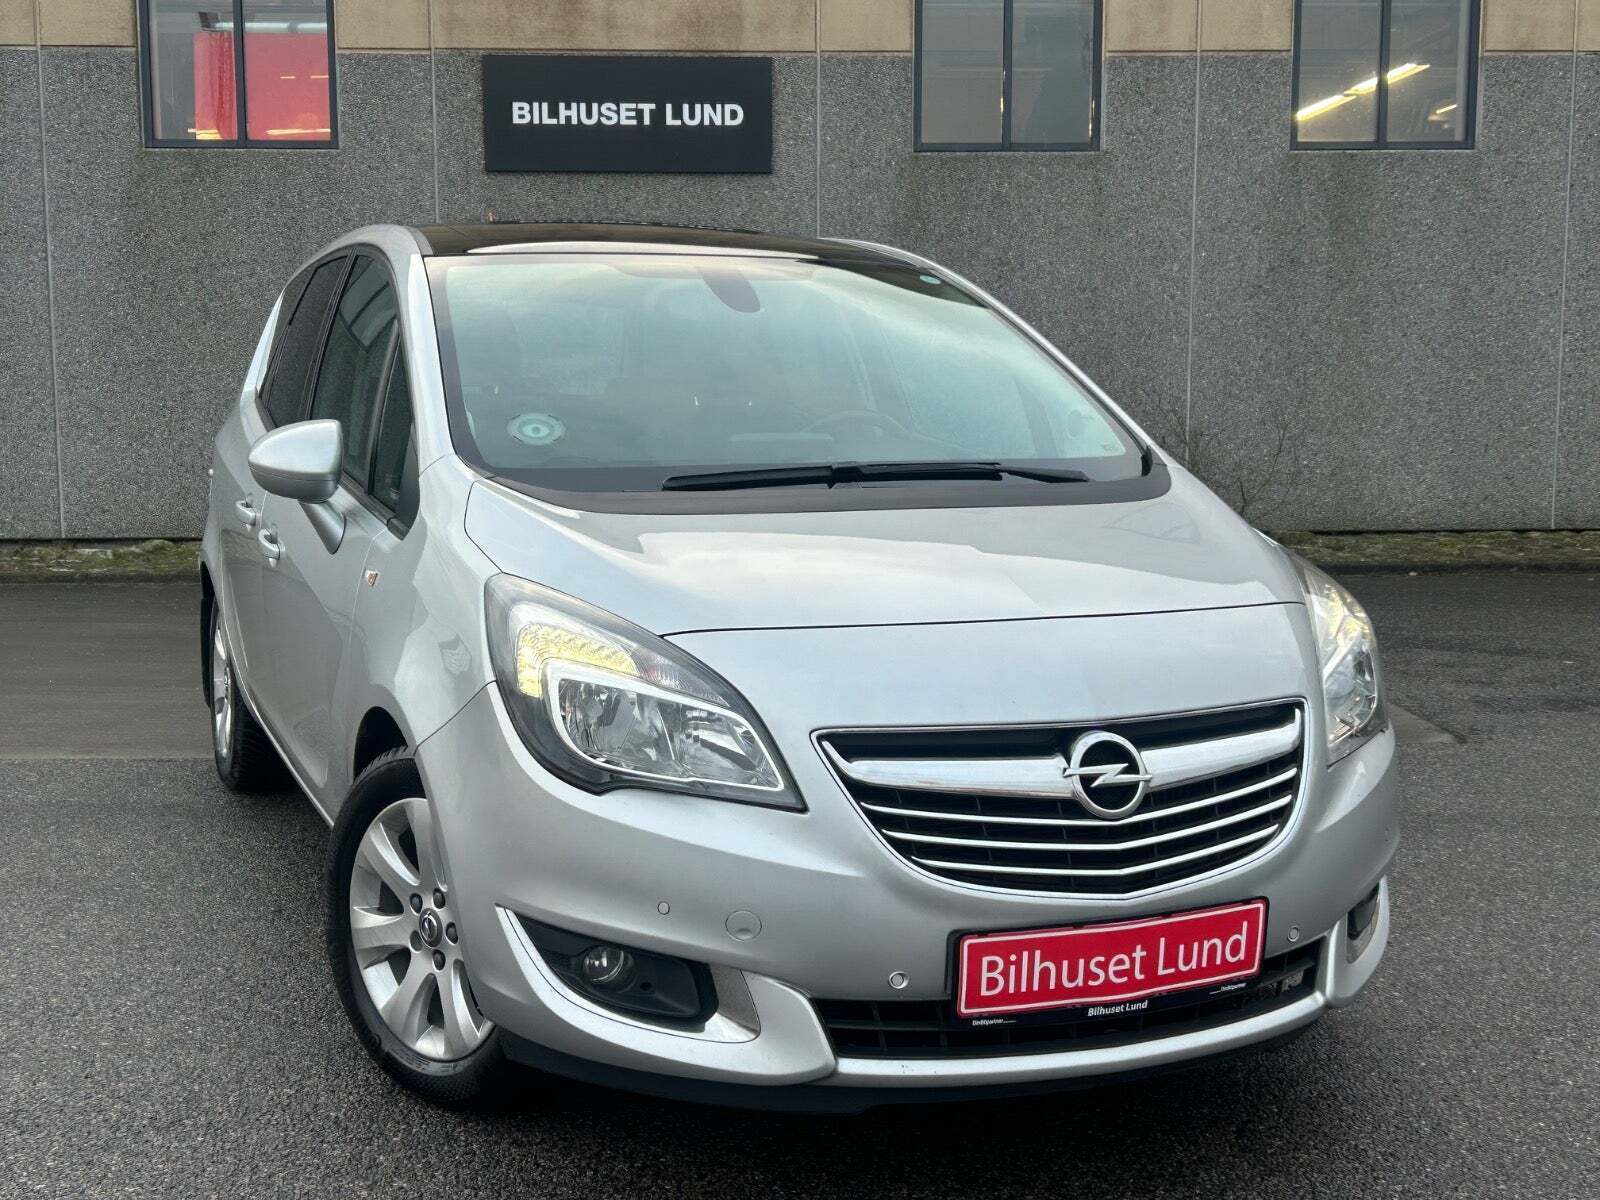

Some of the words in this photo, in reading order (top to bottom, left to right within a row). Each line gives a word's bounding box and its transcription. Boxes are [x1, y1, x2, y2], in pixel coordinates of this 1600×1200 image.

[511, 101, 656, 126] BILHUSET
[665, 102, 745, 127] LUND
[979, 944, 1147, 997] Bilhuset
[1157, 920, 1249, 976] Lund
[1087, 1004, 1125, 1017] Bilhuset
[1125, 999, 1149, 1012] Lund
